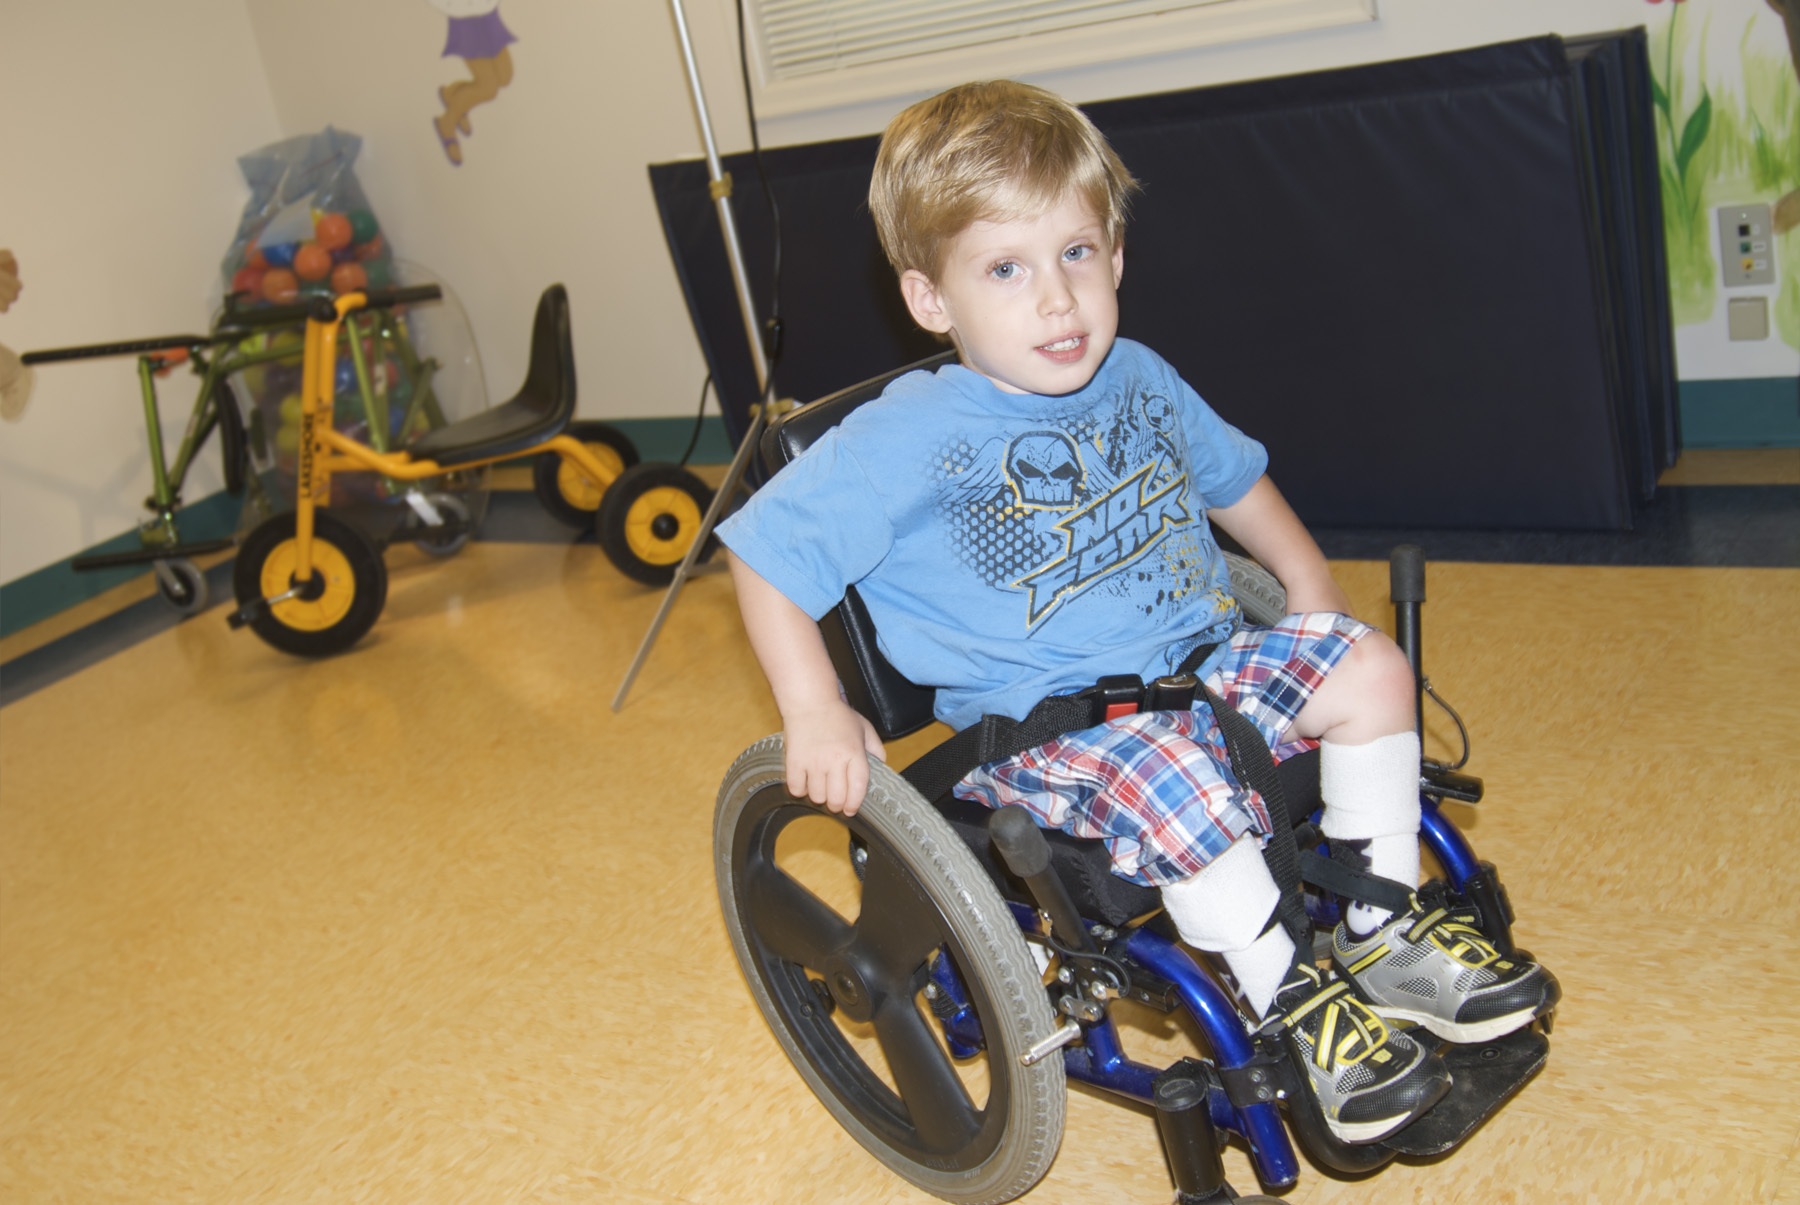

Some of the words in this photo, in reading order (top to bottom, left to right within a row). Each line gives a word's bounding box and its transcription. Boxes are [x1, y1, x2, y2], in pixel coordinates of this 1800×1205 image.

[301, 413, 314, 499] LAKESHORE
[1013, 477, 1191, 626] FEAR
[1060, 466, 1152, 556] NO
